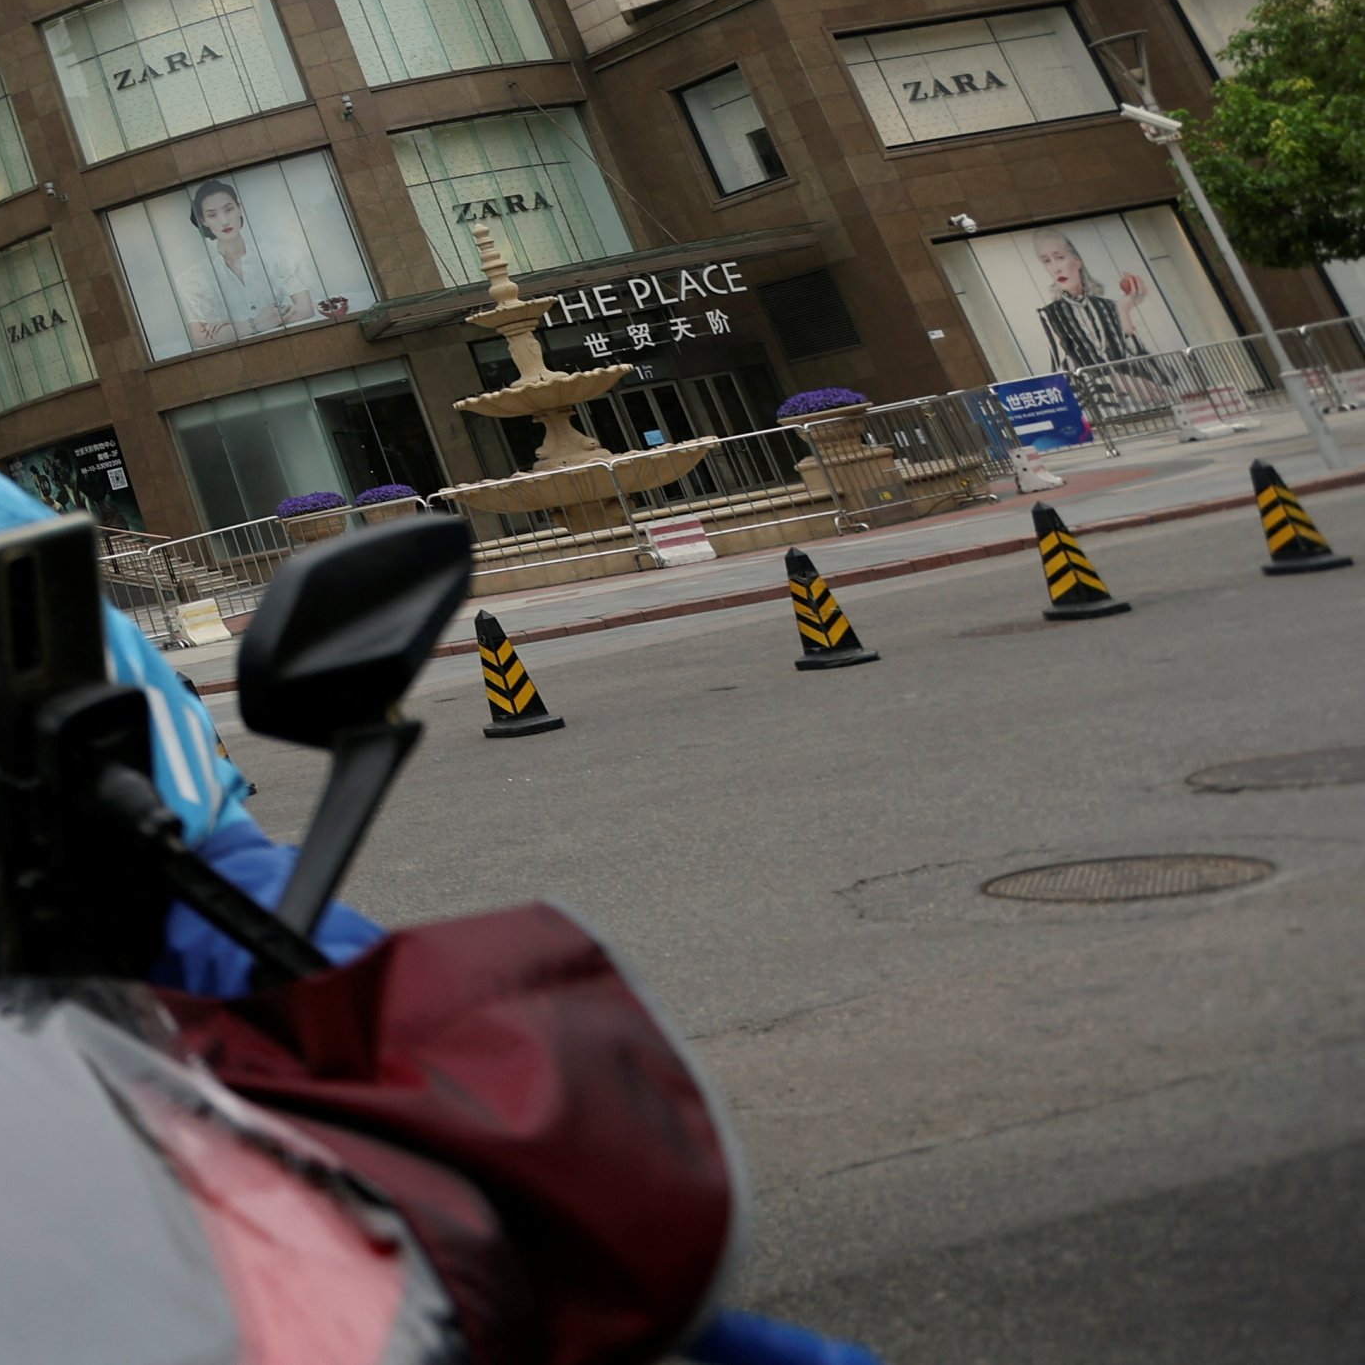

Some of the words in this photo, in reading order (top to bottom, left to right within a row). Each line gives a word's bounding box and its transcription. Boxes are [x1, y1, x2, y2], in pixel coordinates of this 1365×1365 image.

[113, 43, 224, 91] ZARA
[902, 69, 1008, 103] ZARA
[452, 191, 554, 224] ZARA
[627, 261, 748, 309] PLACE
[7, 308, 68, 344] ZARA
[583, 308, 732, 359] 世贸天阶
